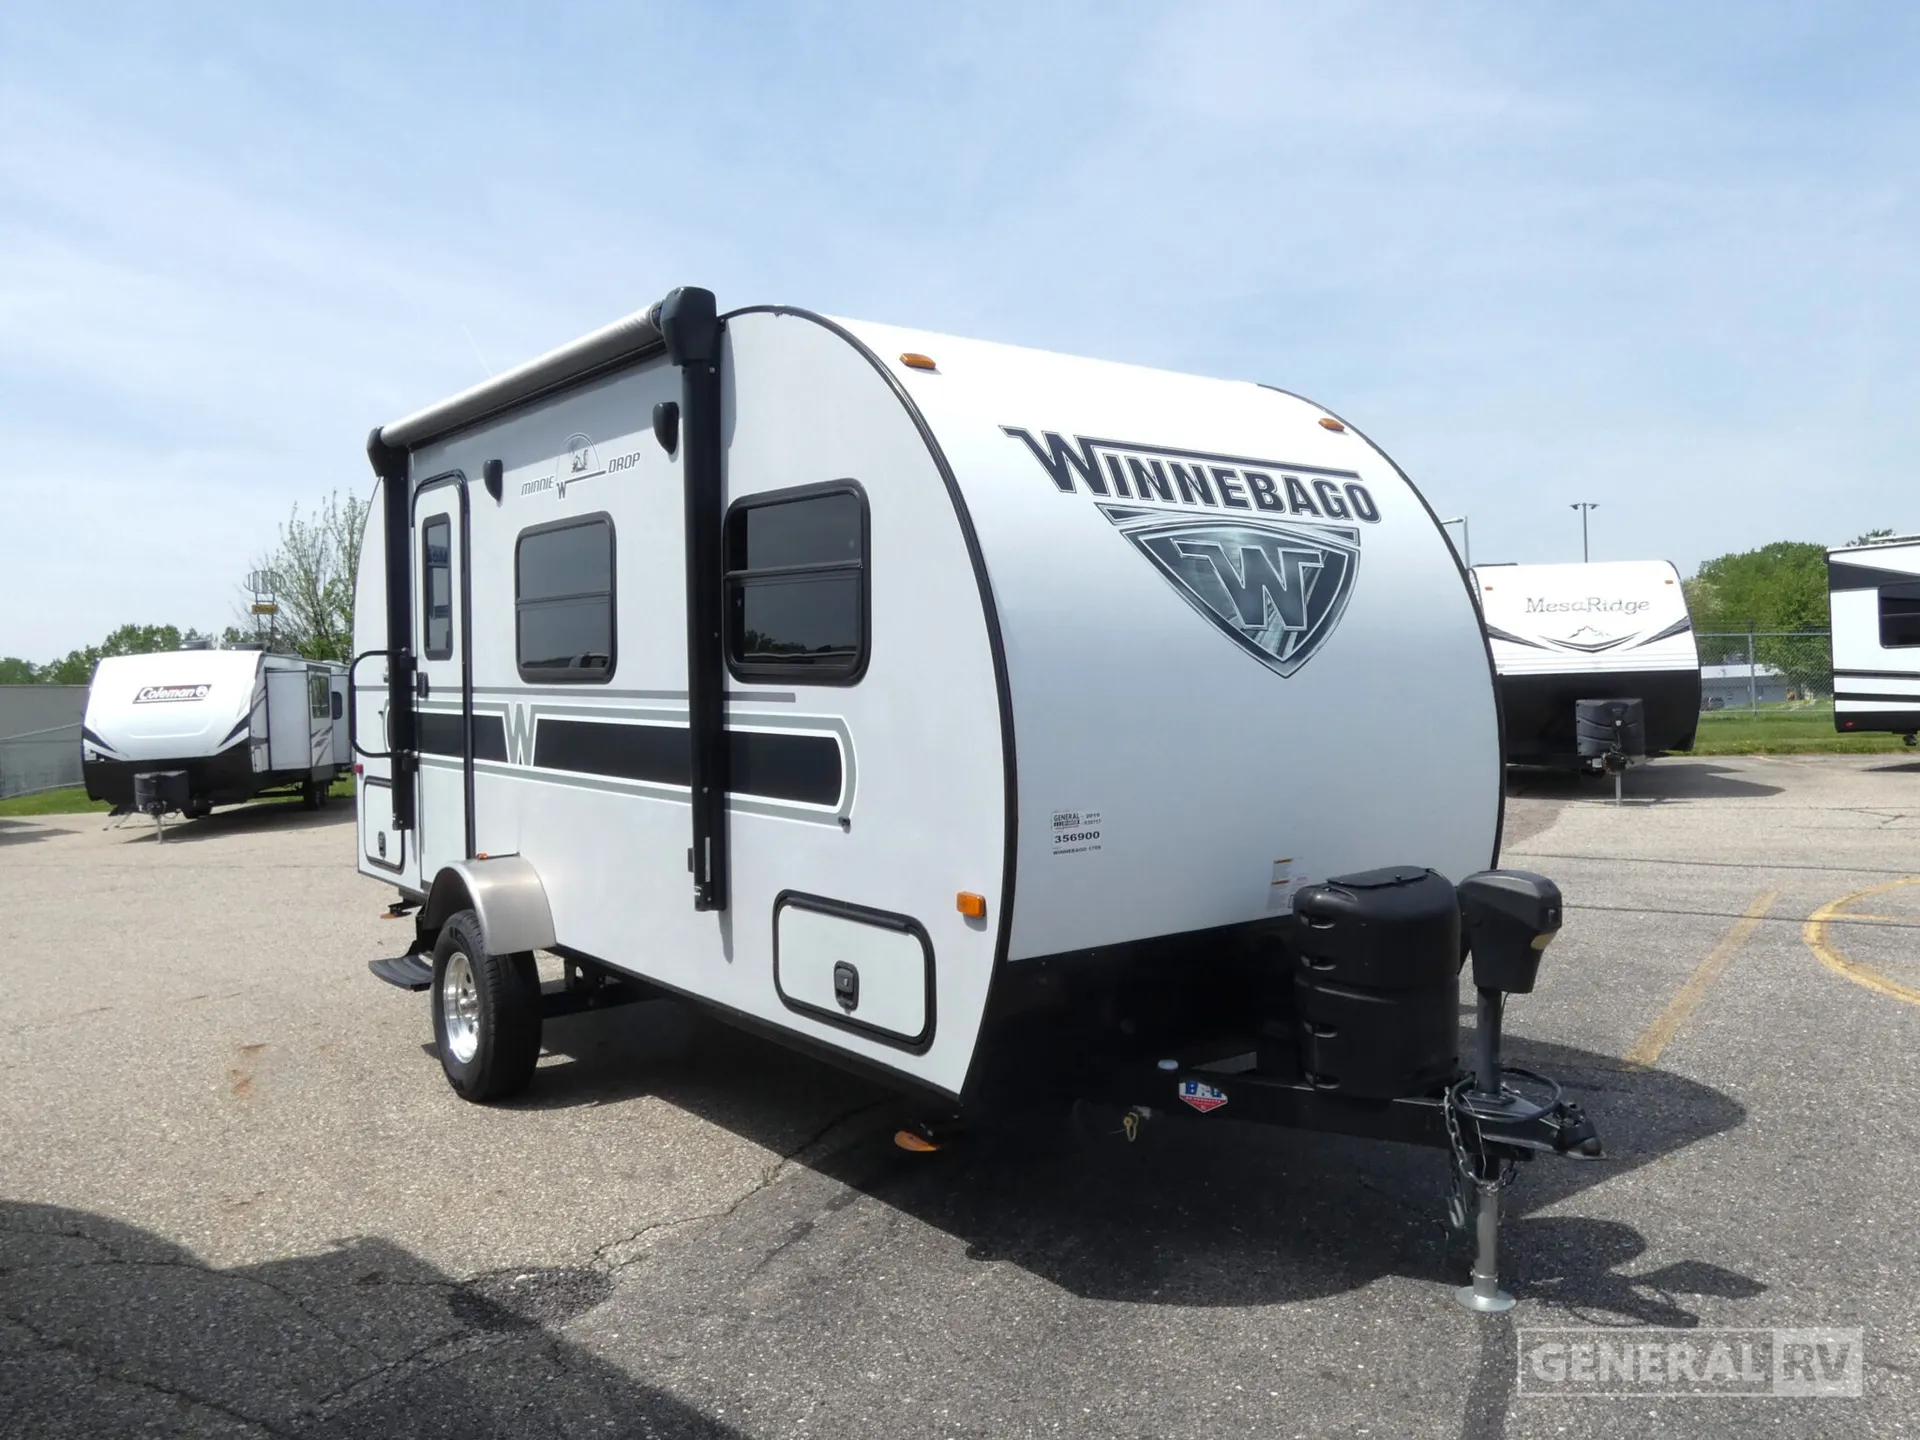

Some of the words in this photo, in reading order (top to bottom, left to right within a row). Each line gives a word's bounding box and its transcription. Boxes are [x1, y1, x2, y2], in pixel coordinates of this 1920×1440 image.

[520, 475, 555, 496] MINNIE
[608, 452, 641, 473] DROP
[999, 425, 1382, 524] WINNEBAGO
[1171, 538, 1325, 630] W
[1525, 597, 1650, 615] MesaRidge
[139, 686, 196, 700] Coleman
[1053, 813, 1079, 821] GENERAL
[1054, 830, 1100, 844] 356900
